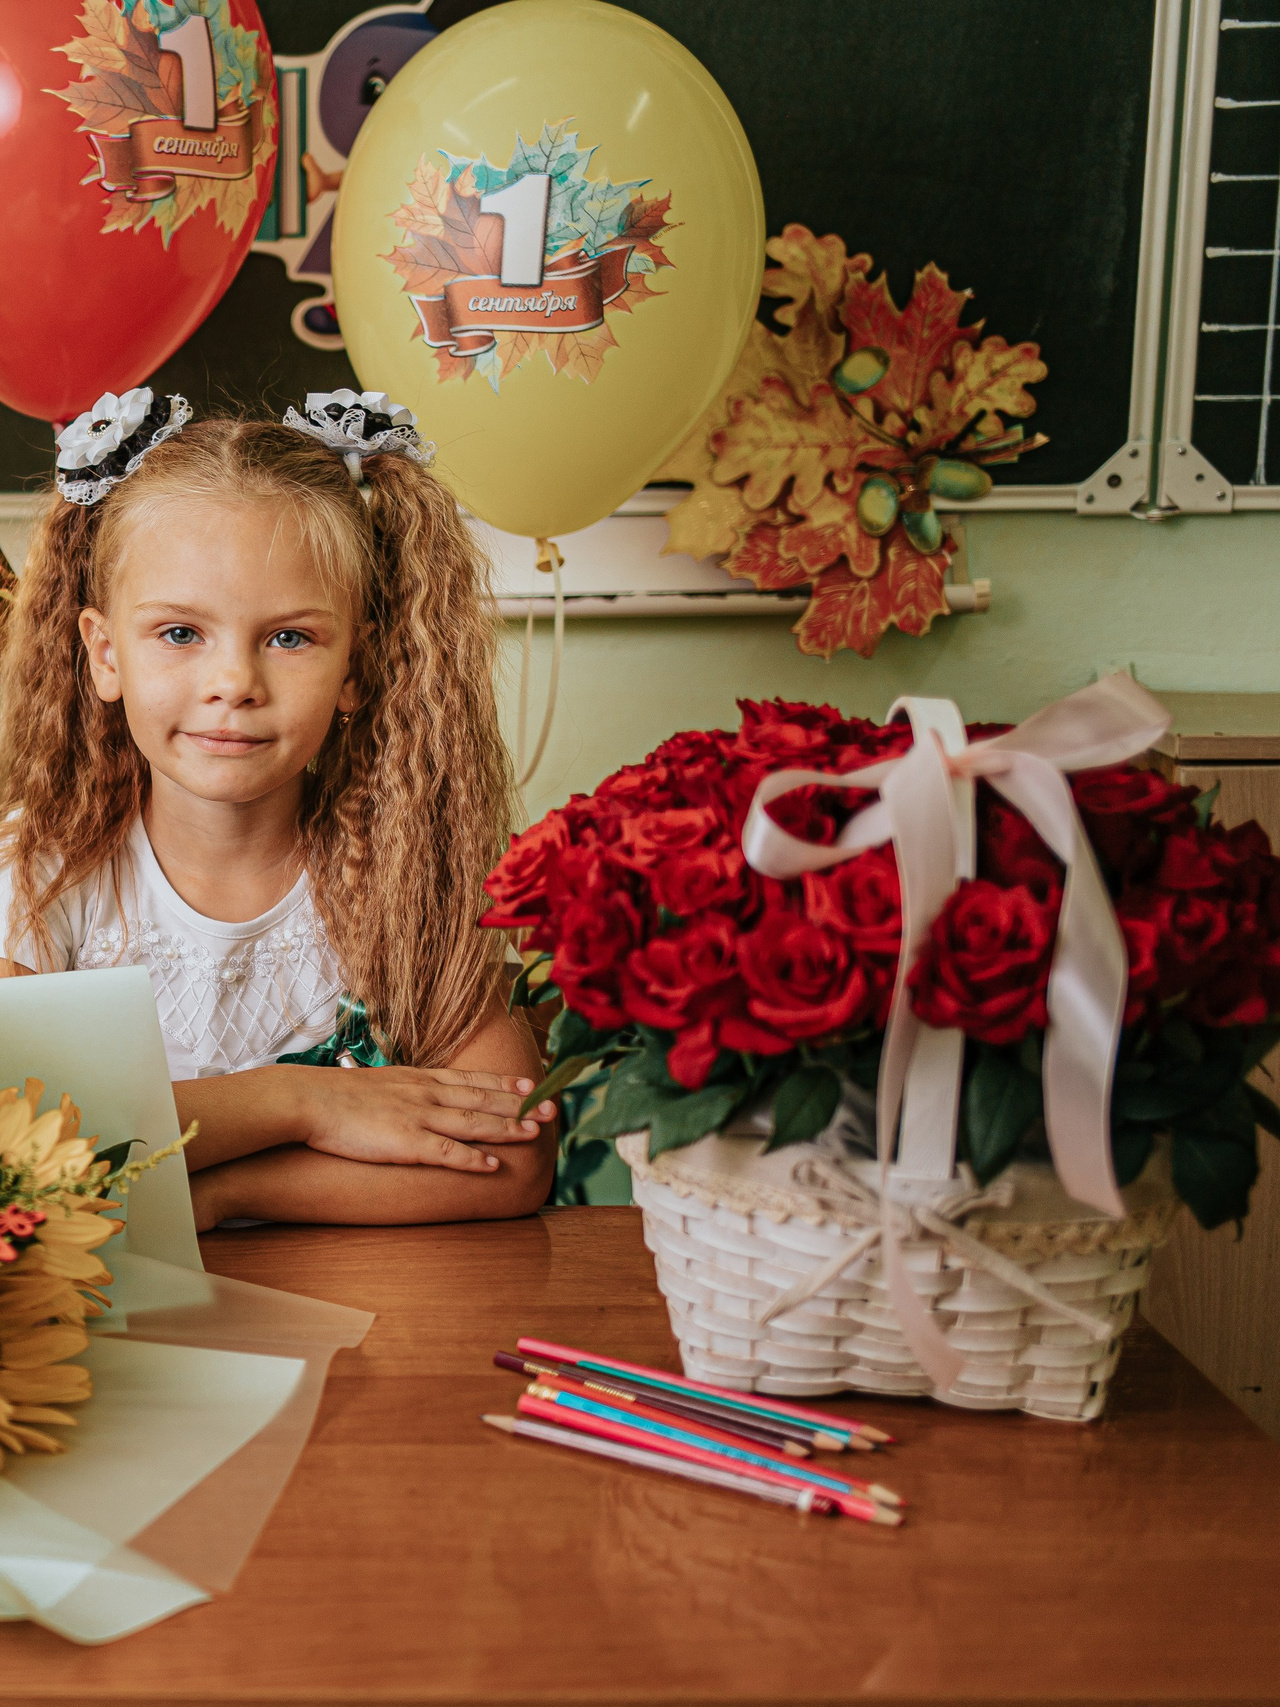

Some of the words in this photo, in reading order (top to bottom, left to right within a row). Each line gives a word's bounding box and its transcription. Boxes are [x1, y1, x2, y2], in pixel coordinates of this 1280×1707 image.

[160, 15, 217, 131] 1
[153, 136, 238, 163] сентября
[480, 173, 552, 287] 1
[468, 290, 578, 318] сентября
